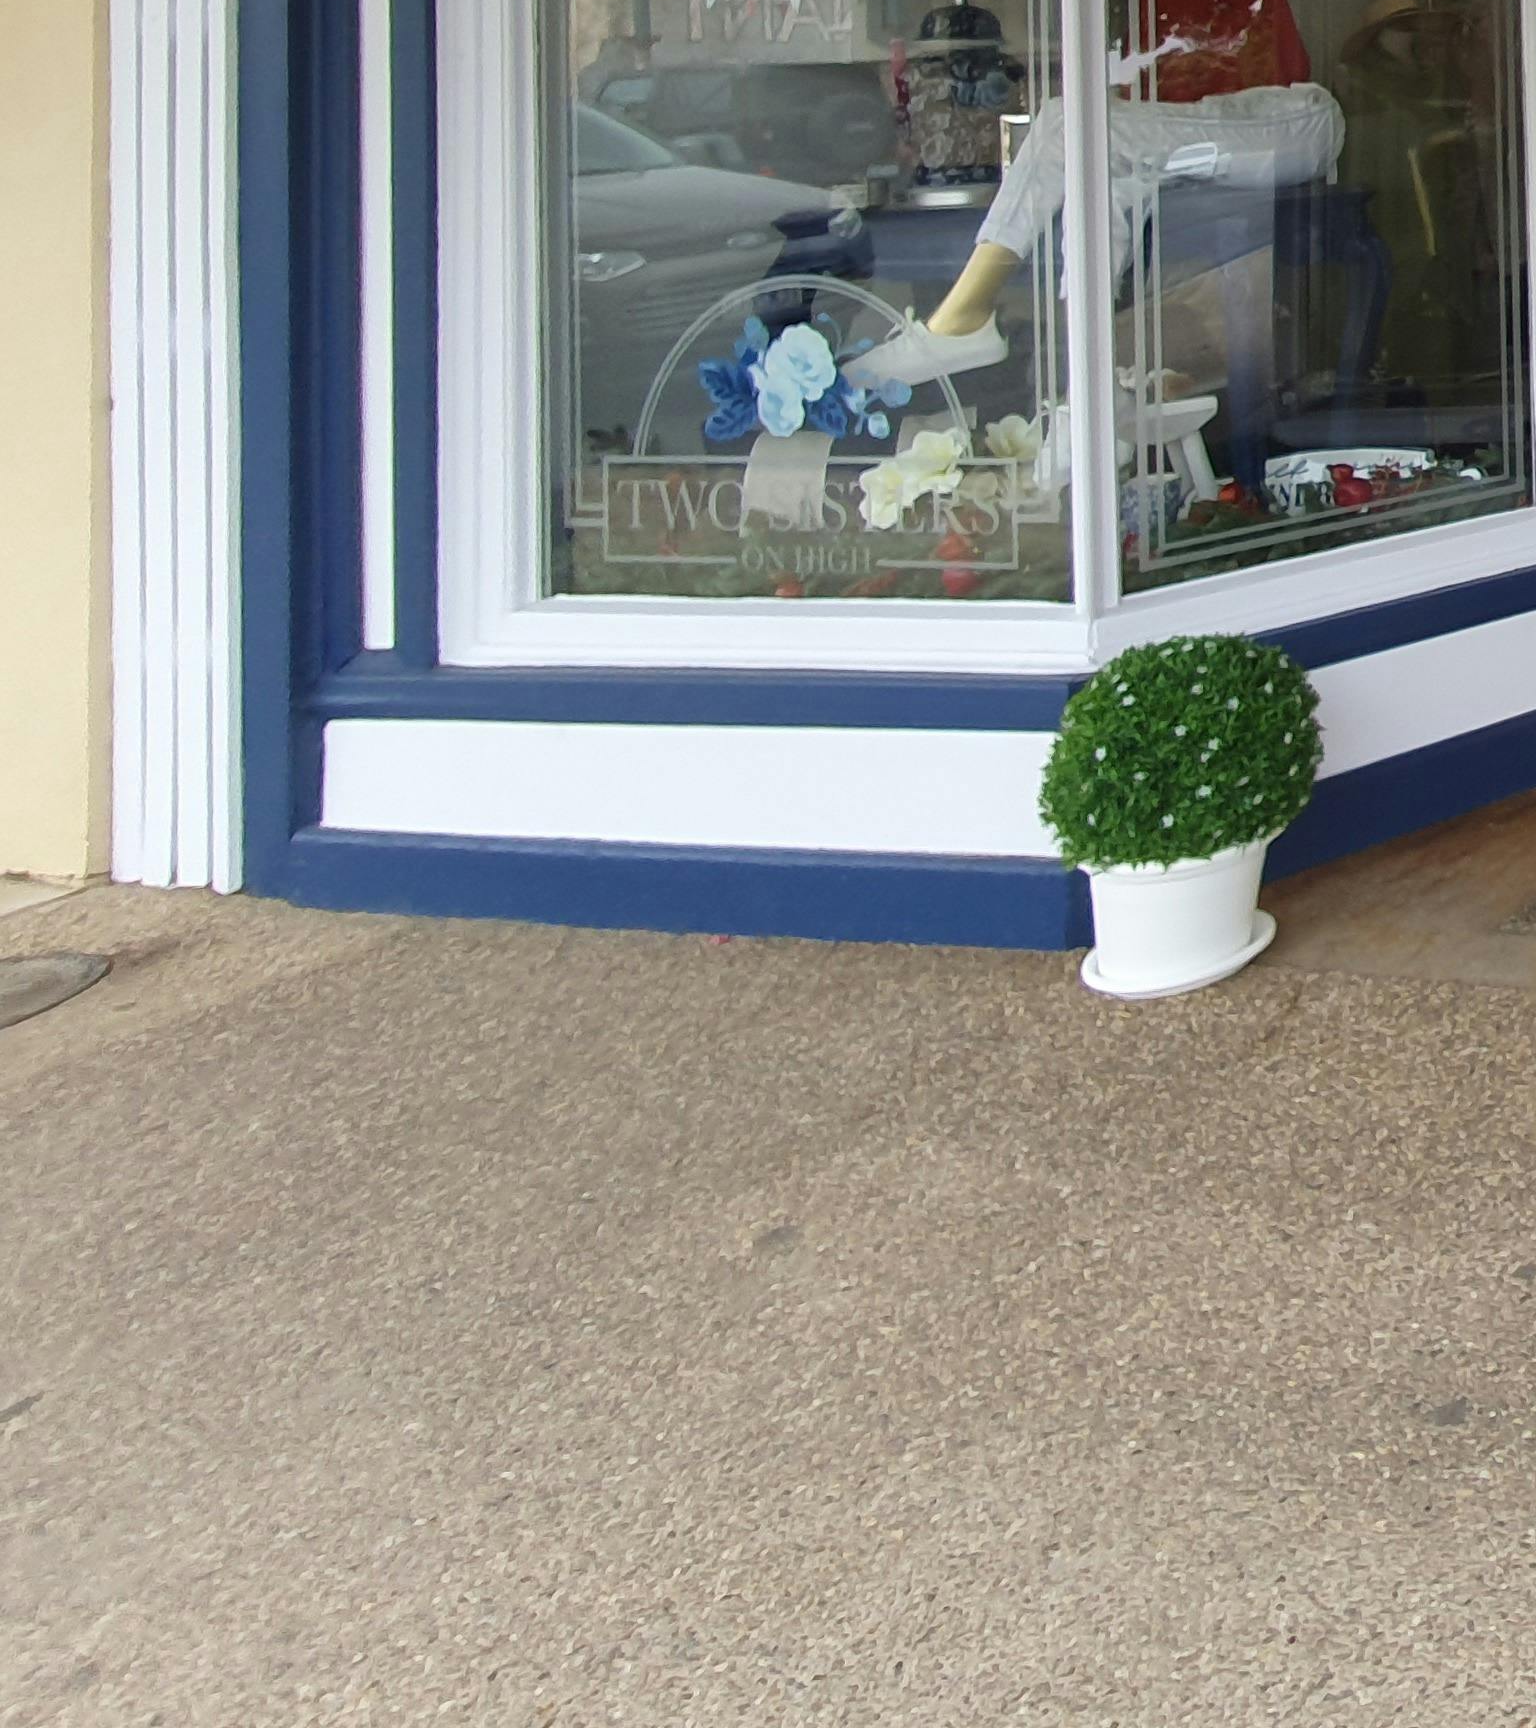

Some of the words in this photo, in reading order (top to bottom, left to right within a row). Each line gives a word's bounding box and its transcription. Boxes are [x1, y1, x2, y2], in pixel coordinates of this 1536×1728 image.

[614, 478, 744, 533] TWO
[741, 544, 785, 572] ON
[794, 545, 872, 576] HIGH
